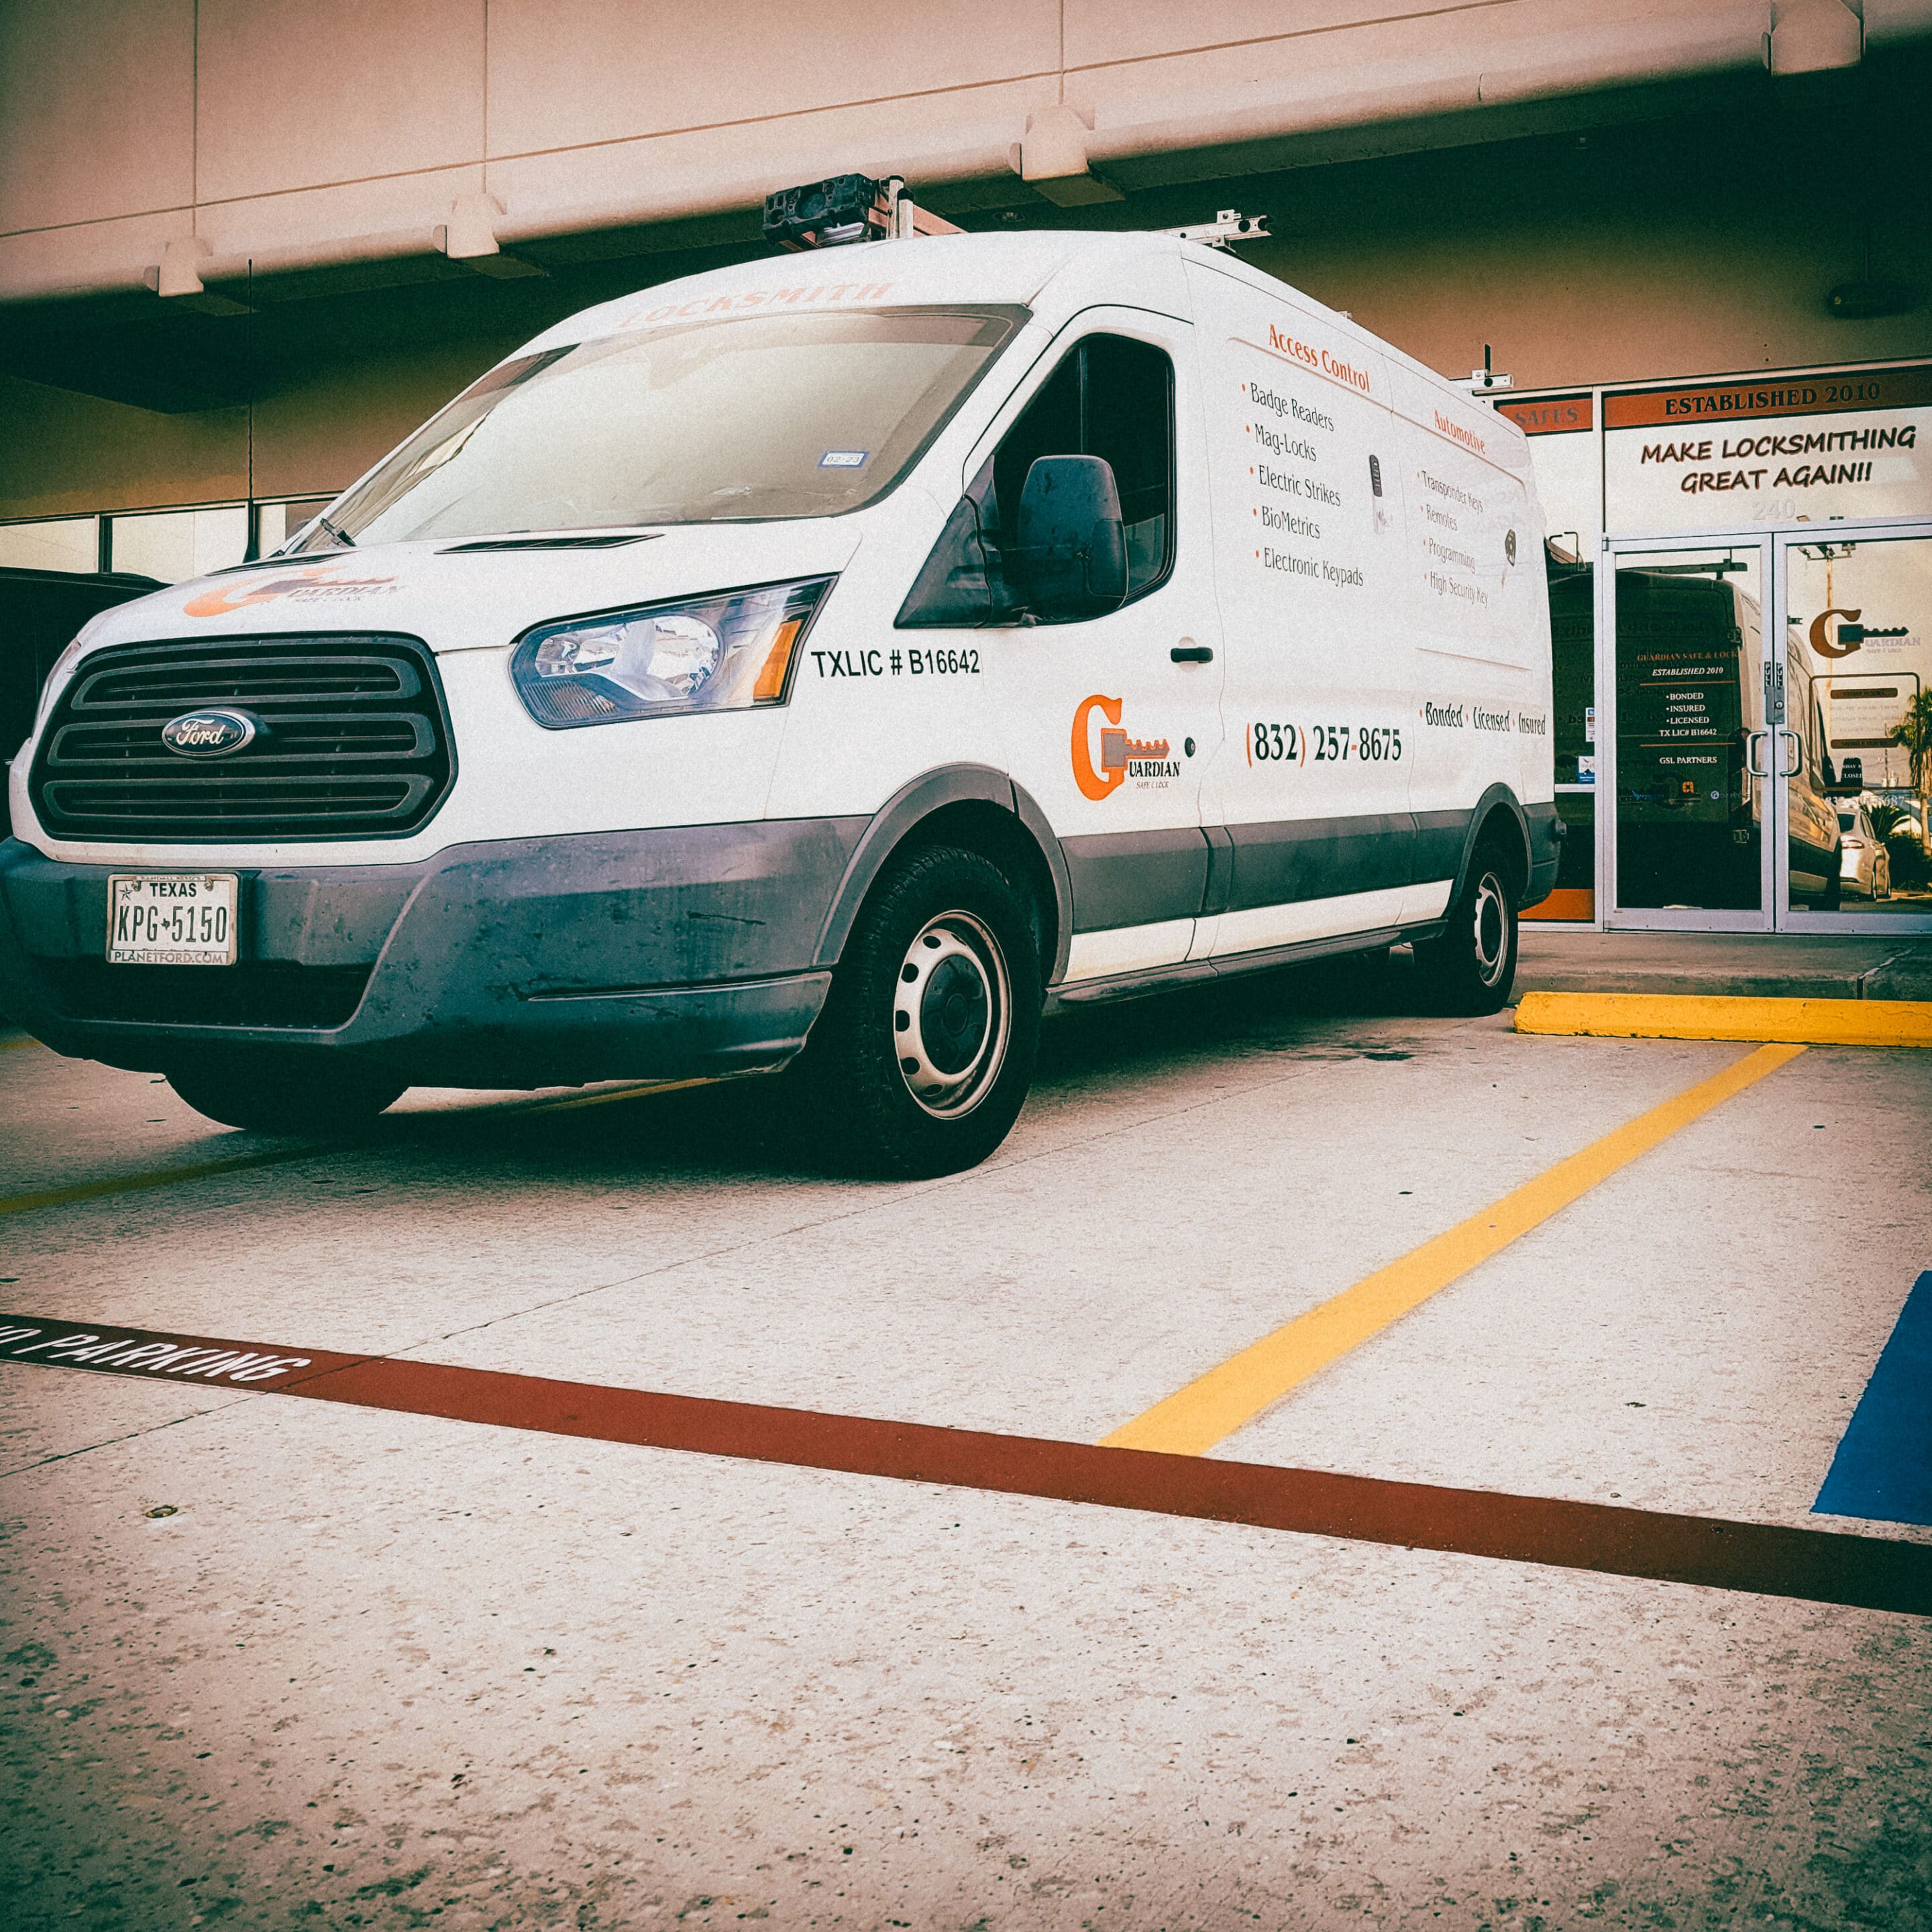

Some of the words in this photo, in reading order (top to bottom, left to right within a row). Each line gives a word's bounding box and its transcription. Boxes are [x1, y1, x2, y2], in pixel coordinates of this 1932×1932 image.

[1269, 323, 1318, 367] Access
[1322, 350, 1371, 392] Control
[1250, 382, 1289, 418] Badge
[1291, 398, 1335, 432] Readers
[1665, 387, 1817, 416] ESTABLISHED
[1825, 382, 1880, 403] 2010
[1254, 423, 1317, 462] Mag-Locks
[1434, 410, 1486, 455] Automotive
[1641, 439, 1713, 465] MAKE
[1721, 425, 1917, 459] LOCKSMITHING
[1258, 464, 1302, 496] Electric
[1305, 478, 1342, 506] Strikes
[1421, 470, 1467, 505] Transponder
[1680, 469, 1768, 494] GREAT
[1772, 462, 1873, 488] AGAIN!!
[1262, 505, 1321, 539] BioMetrics
[1426, 504, 1458, 531] Remotes
[1264, 547, 1320, 578] Electronic
[1323, 559, 1364, 587] Keypads
[1428, 537, 1476, 574] Programming
[1430, 571, 1448, 596] High
[1449, 578, 1476, 605] Security
[1477, 588, 1489, 608] Key
[810, 649, 883, 678] TXLIC
[889, 649, 903, 676] #
[908, 649, 981, 675] B16642
[1637, 653, 1681, 662] GUARDIAN
[1682, 651, 1703, 660] SAFE
[1652, 667, 1705, 677] ESTABLISHED
[1706, 667, 1724, 675] 2010
[1670, 692, 1705, 700] BONDED
[1670, 704, 1706, 712] INSURED
[176, 718, 225, 746] Ford
[1425, 702, 1464, 728] Bonded
[1472, 706, 1510, 732] Licensed
[1518, 712, 1546, 736] Insured
[1670, 716, 1710, 724] LICENSED
[1246, 722, 1306, 769] (832)
[1313, 726, 1402, 761] 257-8675
[1676, 756, 1717, 764] PARTNERS
[150, 882, 197, 898] TEXAS
[114, 951, 223, 964] PLANETFORD.COM
[11, 1334, 312, 1381] PARKING
